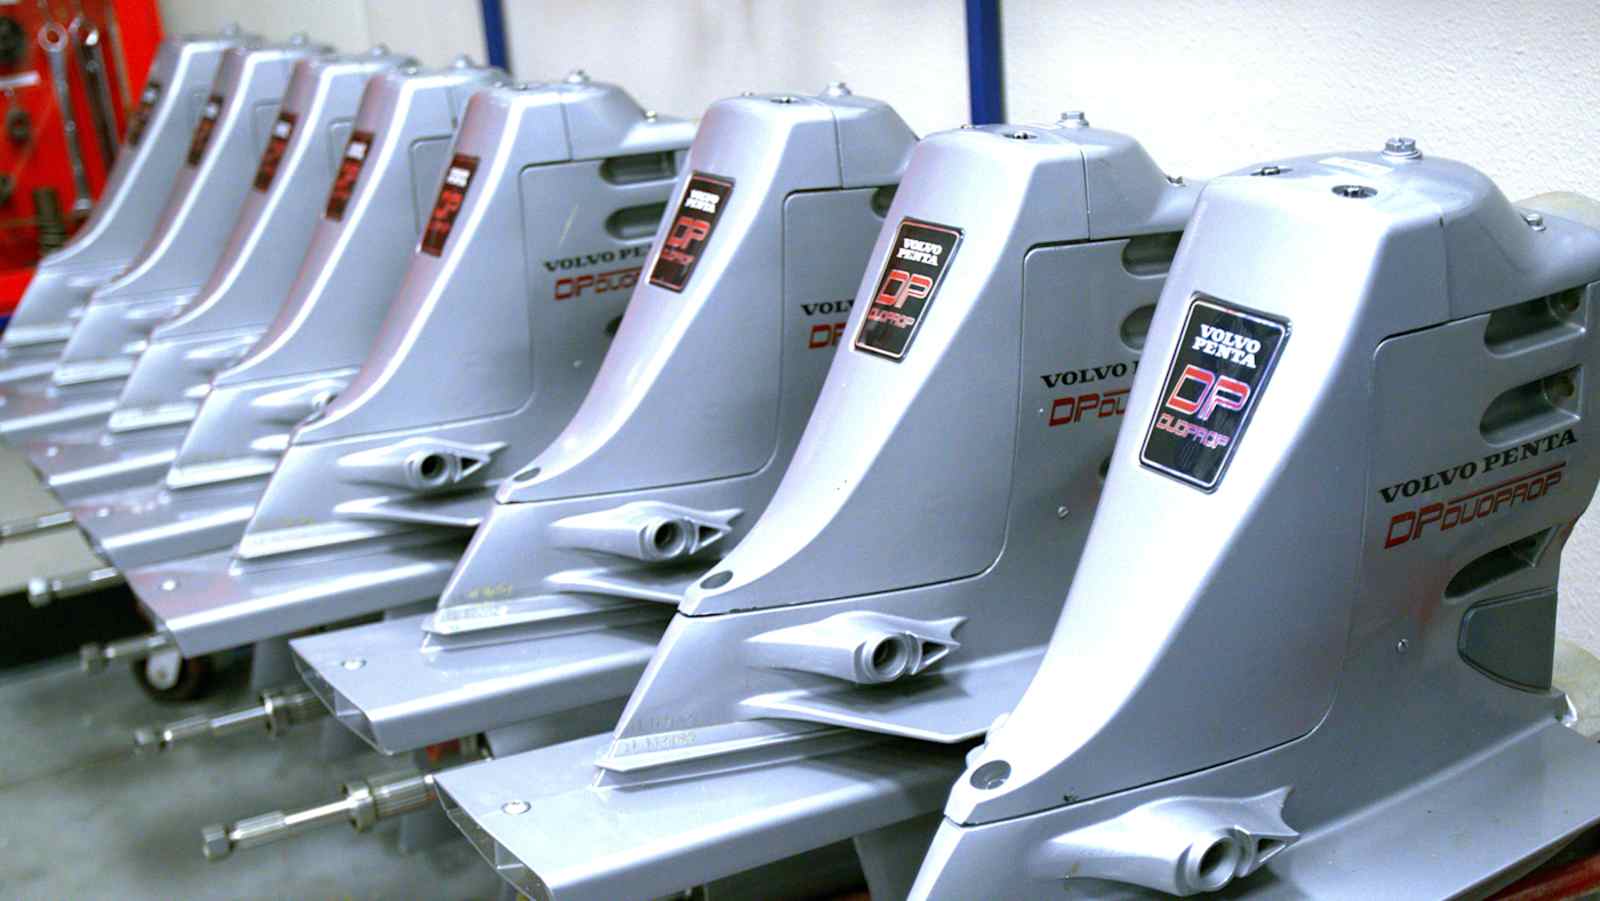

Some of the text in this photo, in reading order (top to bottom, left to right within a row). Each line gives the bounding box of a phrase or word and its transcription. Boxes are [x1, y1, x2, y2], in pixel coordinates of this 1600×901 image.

[544, 251, 615, 272] VOLVO
[896, 248, 938, 266] PENTA
[903, 238, 943, 255] VOLVO
[875, 269, 933, 308] DP
[800, 299, 854, 316] VOL
[1192, 337, 1256, 368] PENTA
[1200, 324, 1262, 354] VOLVO
[1040, 363, 1127, 388] VOLVO
[1166, 364, 1251, 421] DP
[1156, 413, 1231, 449] DUOPROP
[1379, 429, 1577, 503] VOLVO PENTA
